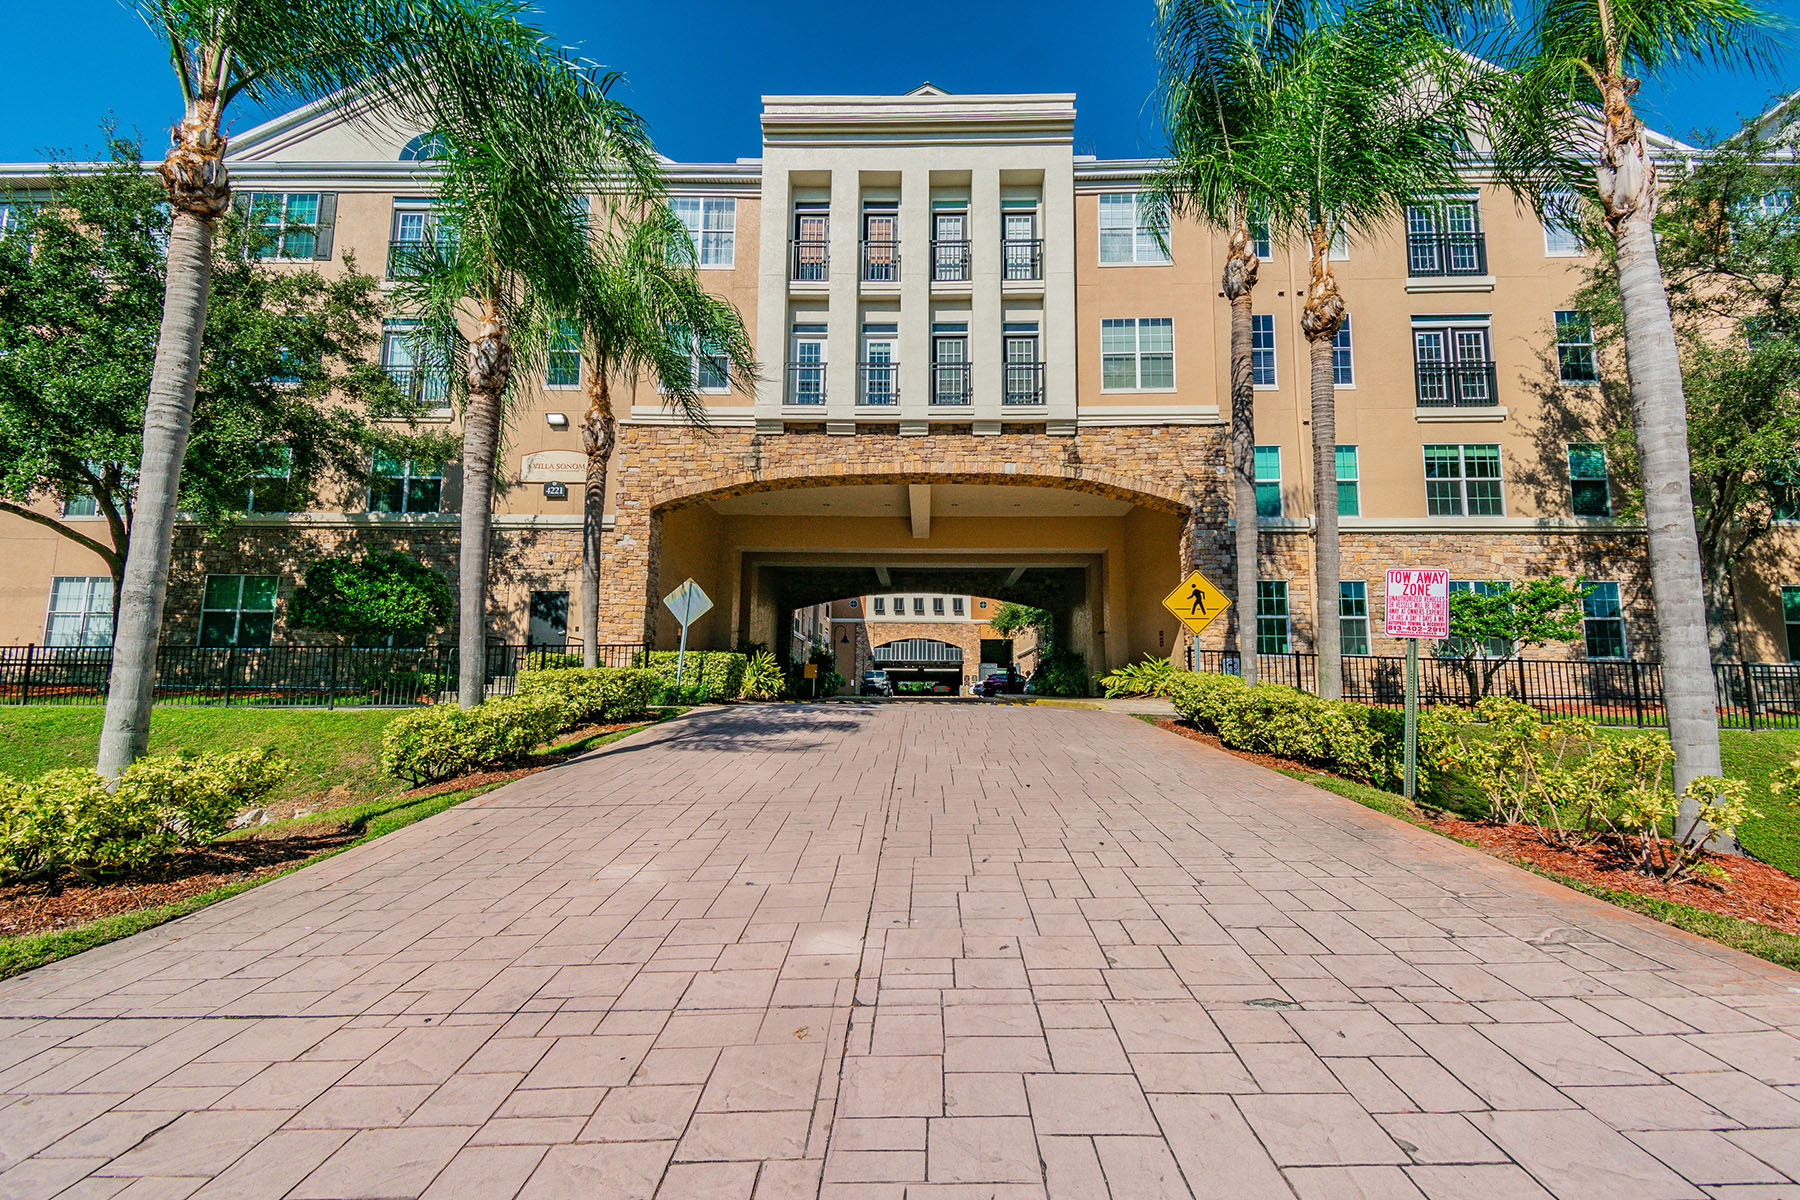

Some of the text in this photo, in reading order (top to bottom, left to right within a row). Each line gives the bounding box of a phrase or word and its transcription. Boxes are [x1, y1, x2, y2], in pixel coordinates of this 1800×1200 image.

[545, 486, 563, 495] 4221
[1390, 571, 1445, 584] TOW AWAY
[1402, 584, 1431, 596] ZONE
